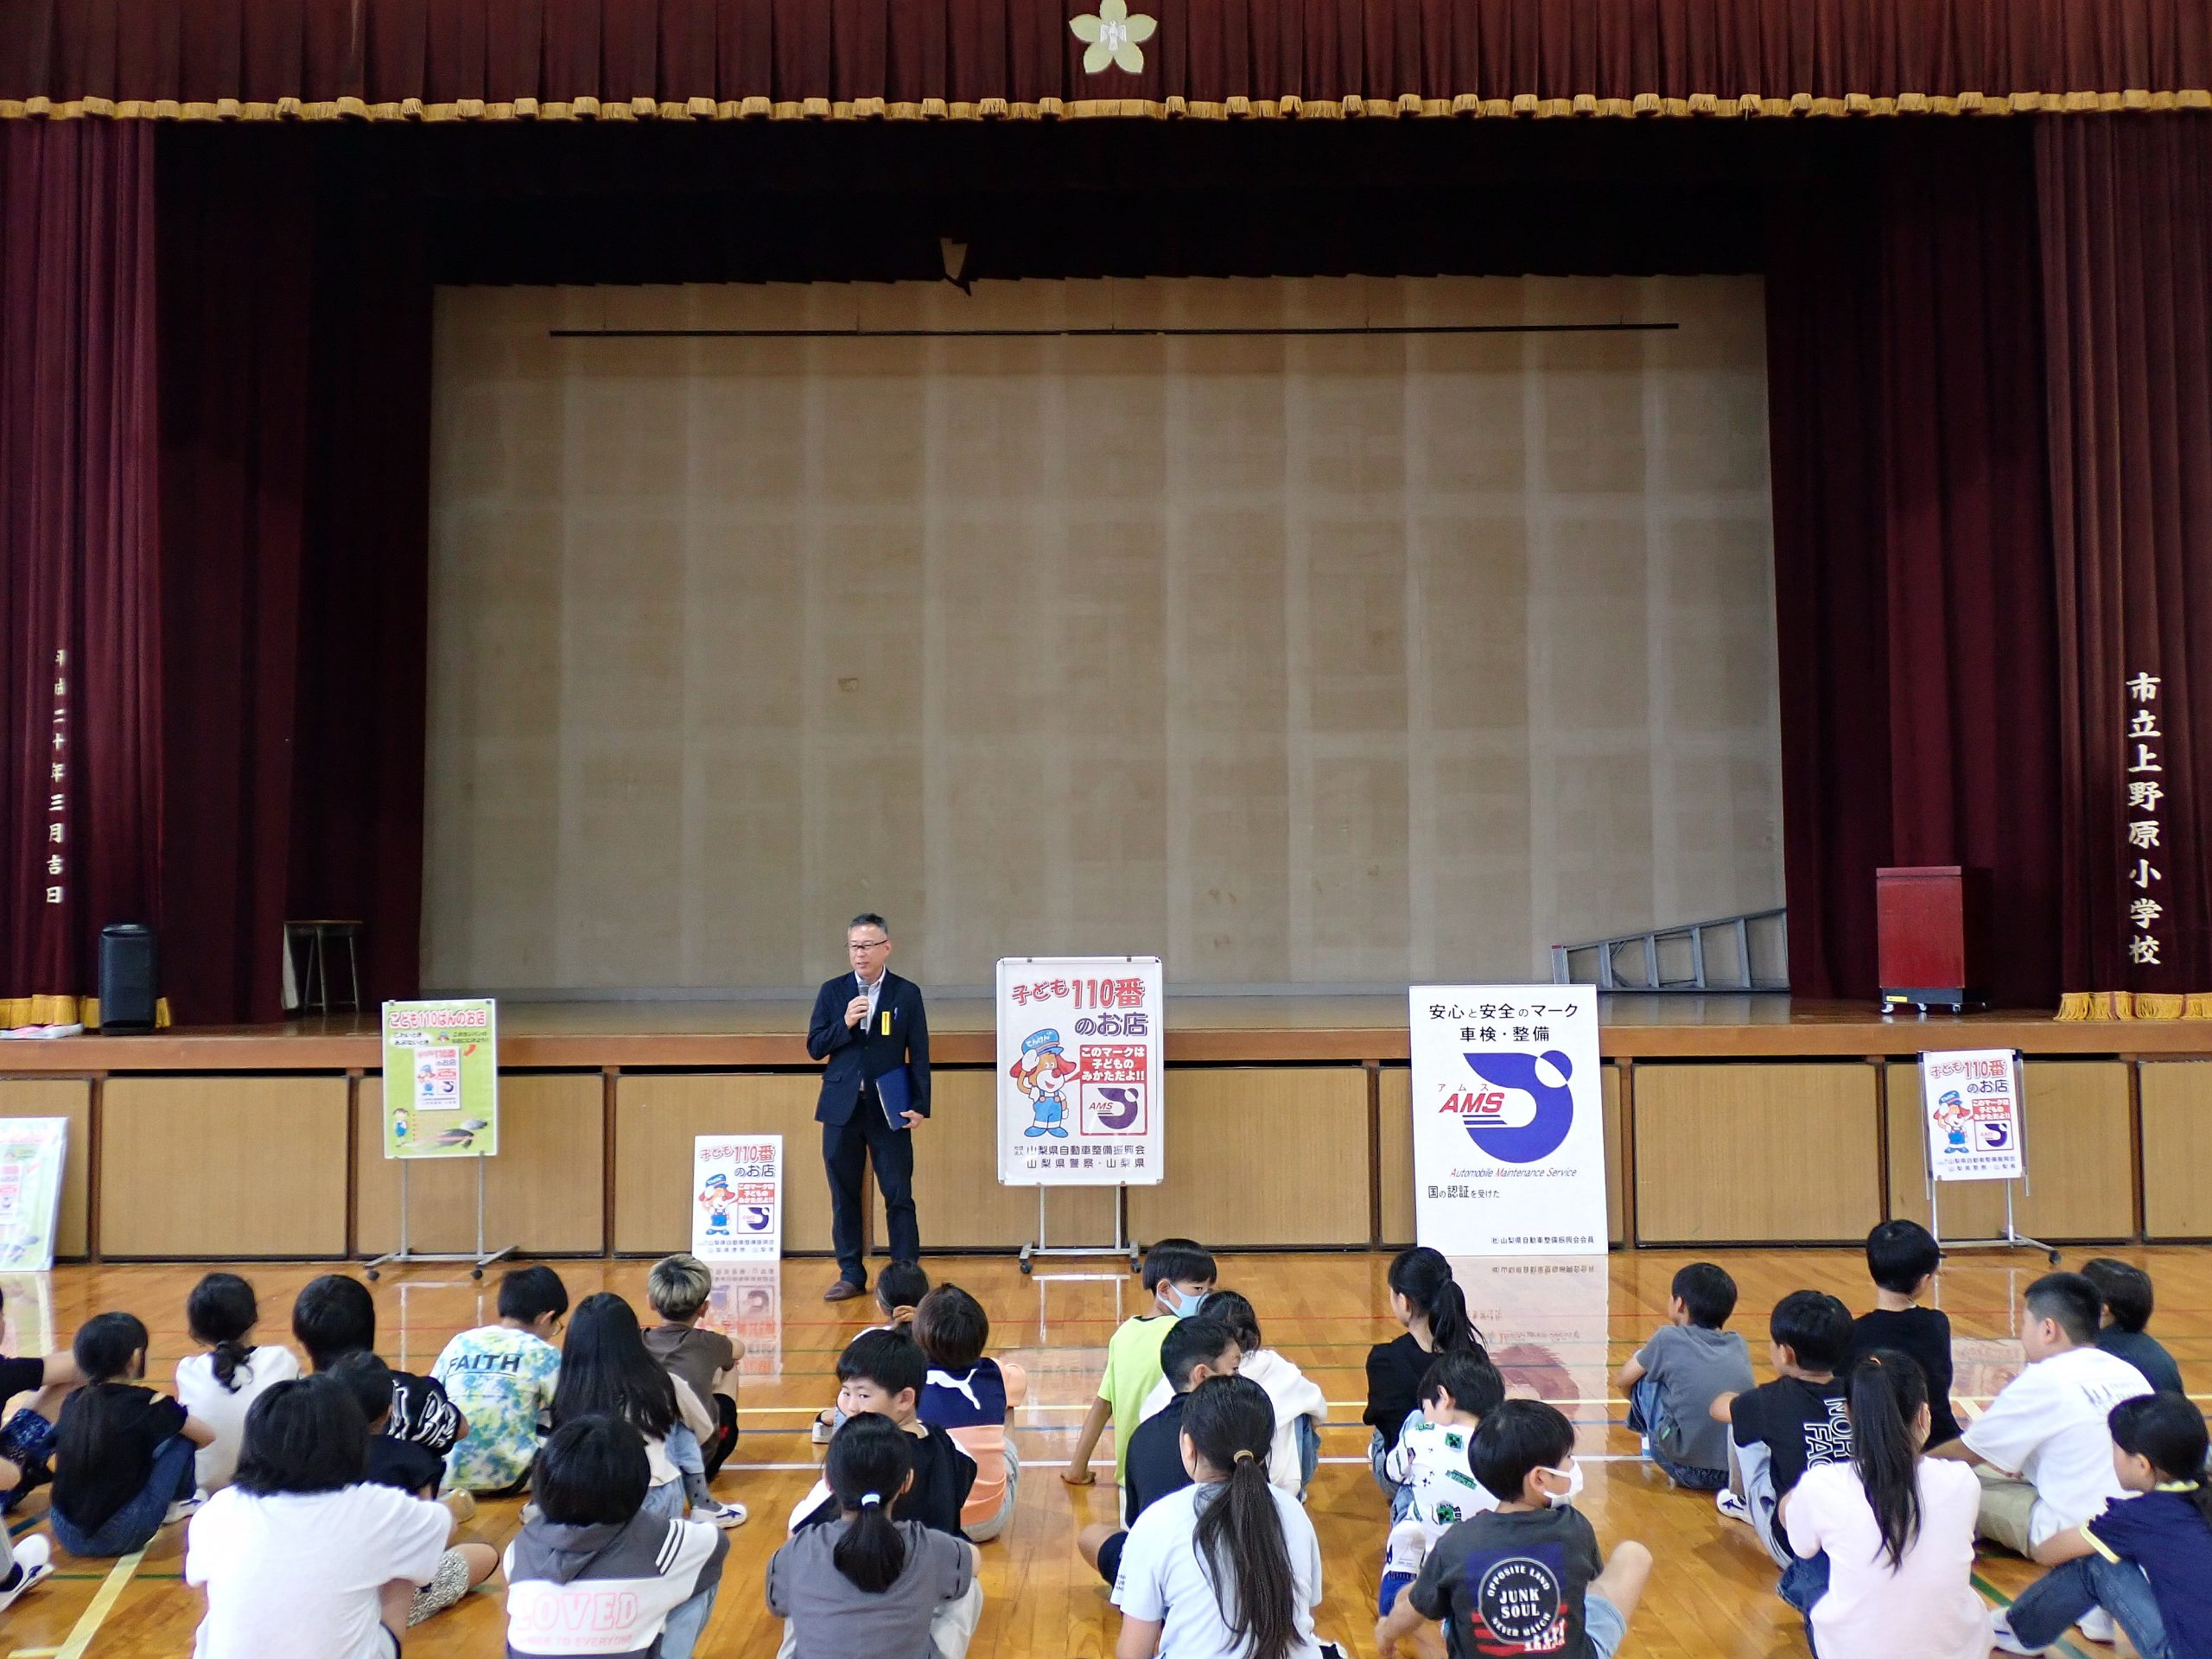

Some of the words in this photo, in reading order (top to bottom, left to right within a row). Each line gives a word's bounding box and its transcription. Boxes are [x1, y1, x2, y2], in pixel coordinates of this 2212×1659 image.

[2126, 671, 2164, 965] 市立上野原小学校
[1012, 977, 1145, 1009] 子ども110番
[1428, 1002, 1579, 1020] 安心と安全のマーク
[1074, 1012, 1148, 1037] のお店
[1081, 1046, 1145, 1058] このマークは
[1091, 1059, 1135, 1070] 子どもの
[1929, 1058, 2007, 1079] 子ども110番
[1967, 1079, 2010, 1094] のお店
[1089, 1102, 1114, 1110] AMS
[1438, 1092, 1505, 1114] AMS
[700, 1144, 775, 1164] 子ども110番
[734, 1164, 775, 1179] のお店
[1450, 1167, 1493, 1178] Automobile
[1495, 1167, 1544, 1178] Maintenance
[1546, 1166, 1578, 1177] Service
[447, 1353, 522, 1373] FAITH
[1487, 1565, 1527, 1598] OPPOSITE
[1529, 1567, 1550, 1591] LAND
[1499, 1587, 1540, 1605] JUNK
[516, 1592, 639, 1631] LOVED
[1500, 1603, 1541, 1619] SOUL
